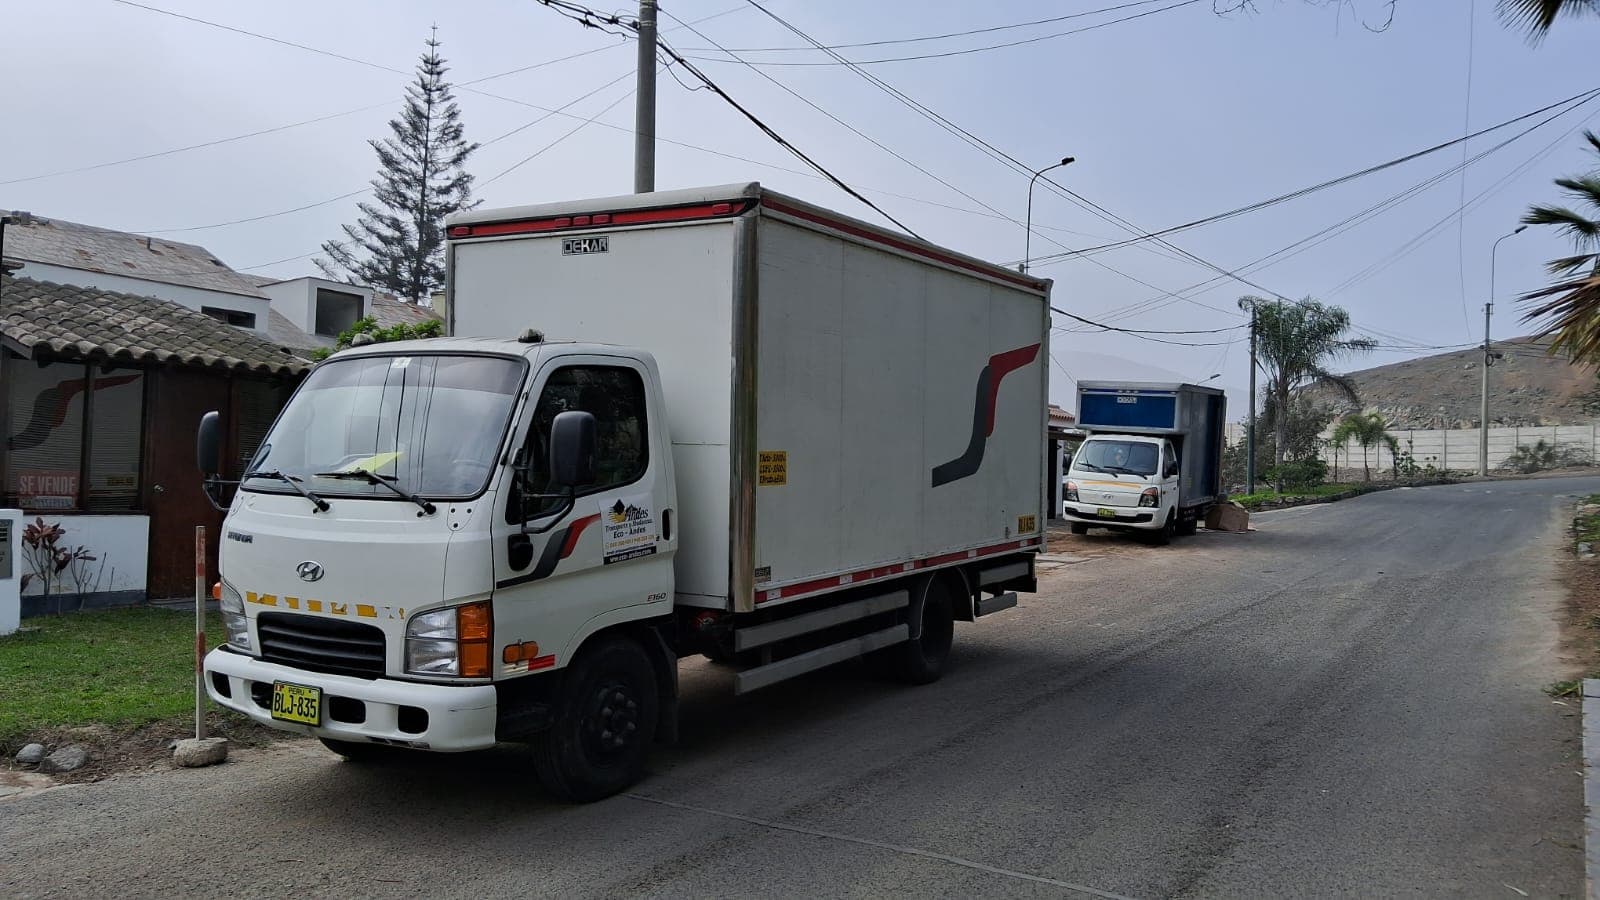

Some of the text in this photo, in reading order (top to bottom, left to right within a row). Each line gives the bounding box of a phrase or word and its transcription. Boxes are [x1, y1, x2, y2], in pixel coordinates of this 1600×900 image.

[563, 238, 608, 254] DEKAR
[20, 474, 76, 494] SE VENDE
[613, 531, 624, 539] Eco
[629, 526, 646, 535] Andes
[274, 692, 317, 719] BLJ-835
